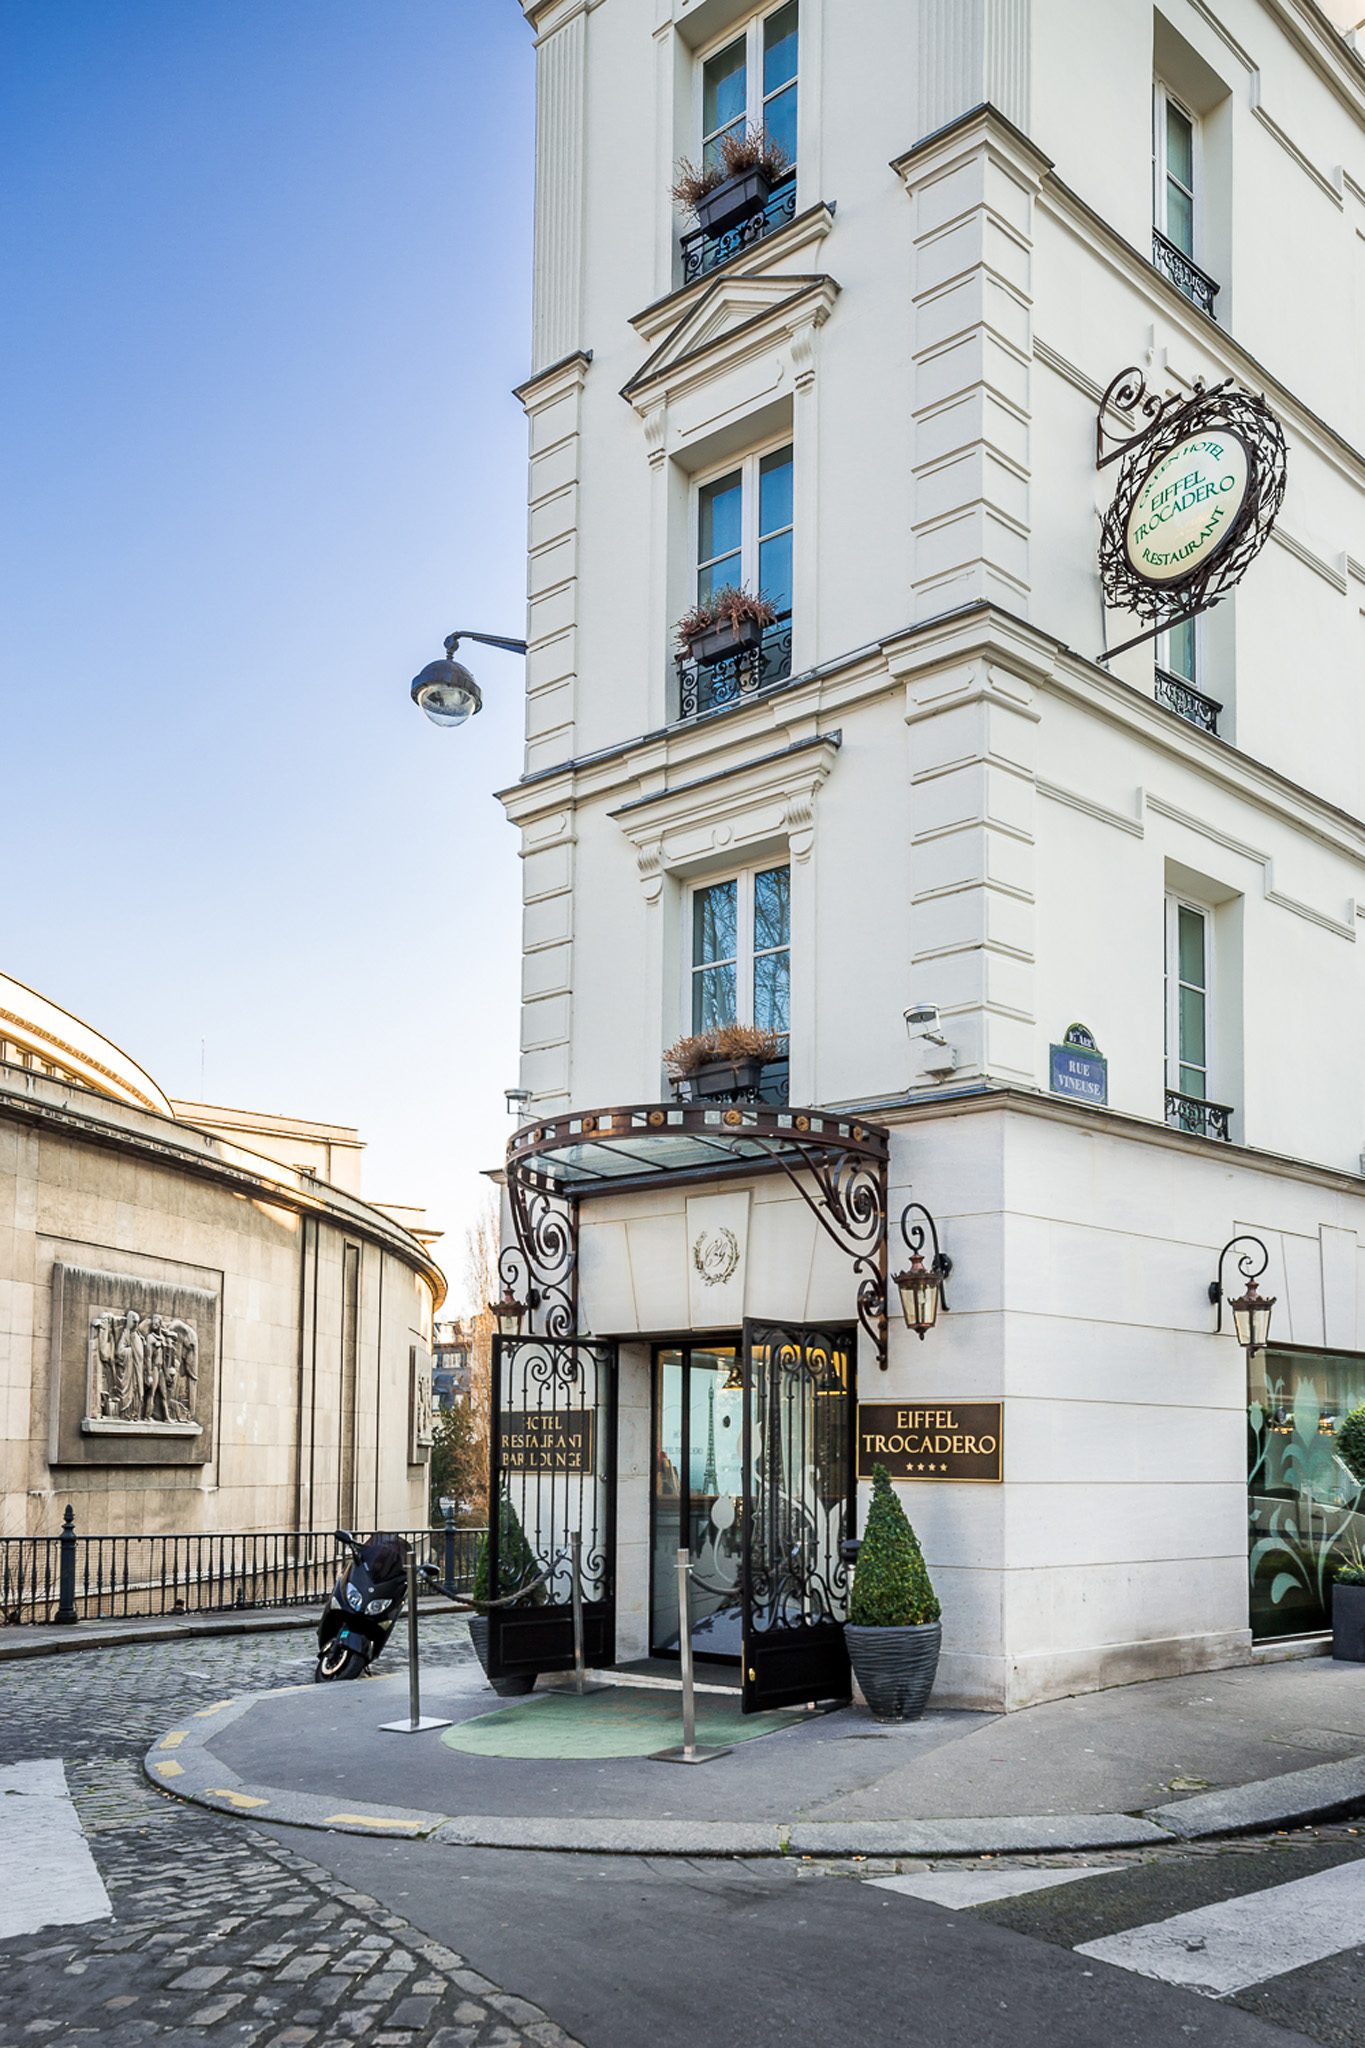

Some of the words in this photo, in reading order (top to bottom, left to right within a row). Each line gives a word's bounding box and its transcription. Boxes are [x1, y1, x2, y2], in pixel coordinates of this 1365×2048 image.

[1183, 441, 1224, 461] HOTEL
[1151, 470, 1206, 512] EIFFEL
[1134, 475, 1235, 544] TROCADERO
[1142, 506, 1225, 566] RESTAURANT
[1068, 1060, 1090, 1077] RUE
[1058, 1074, 1101, 1095] VINEUSE
[897, 1410, 958, 1429] EIFFEL
[862, 1434, 996, 1454] TROCADERO
[502, 1452, 524, 1466] BAR
